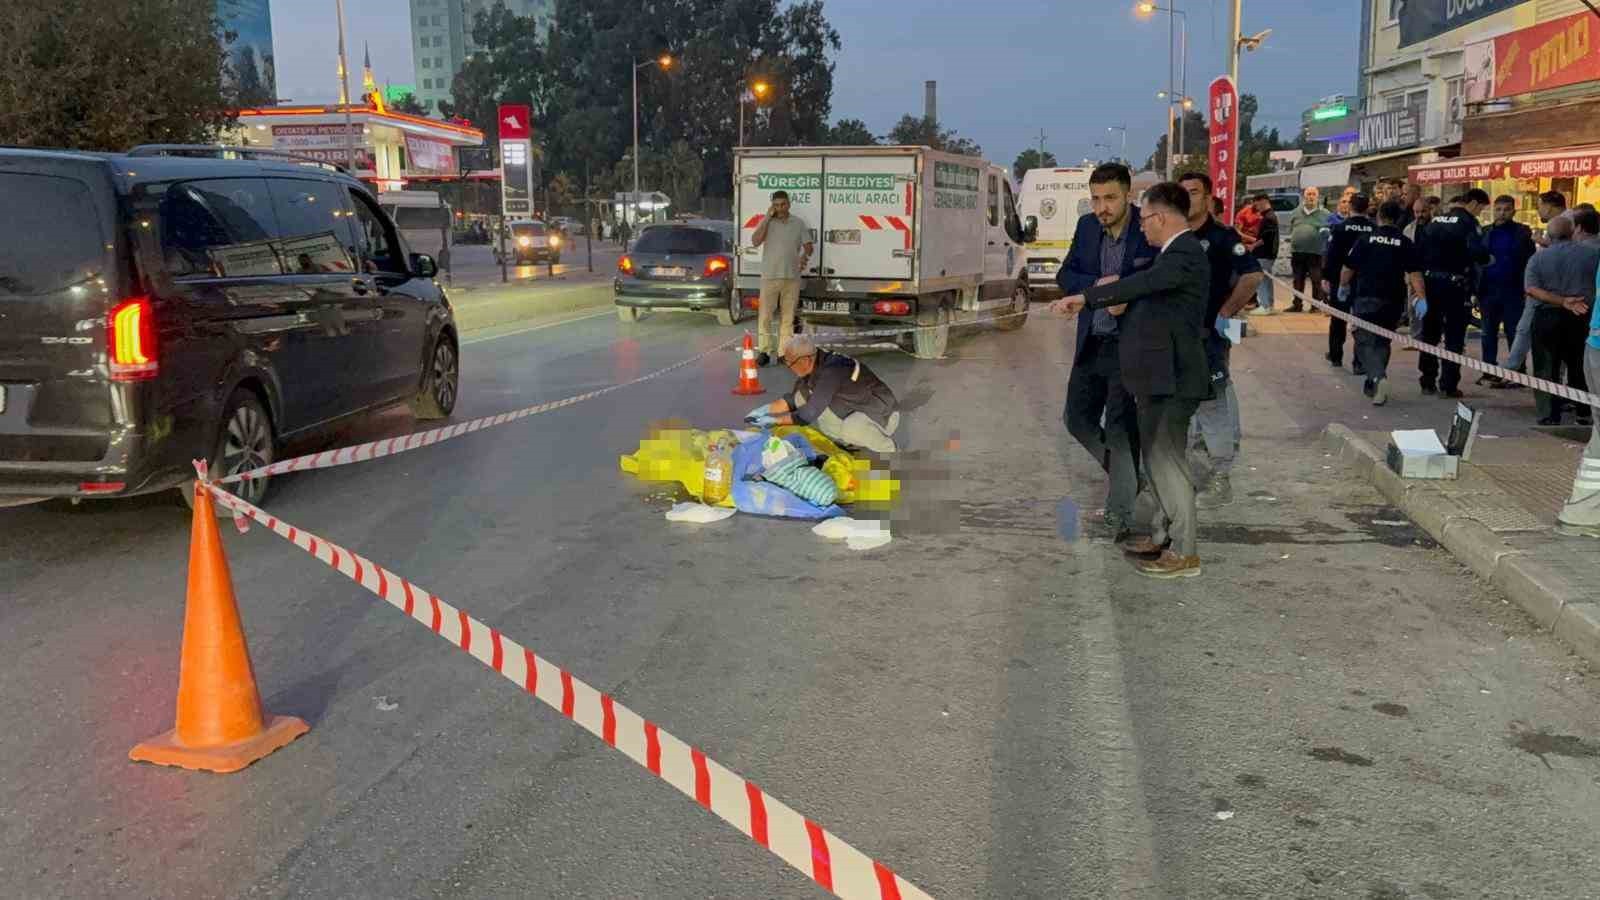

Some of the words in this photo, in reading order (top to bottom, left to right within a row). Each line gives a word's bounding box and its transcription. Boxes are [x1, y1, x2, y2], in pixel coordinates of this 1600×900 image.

[1360, 112, 1399, 152] AKYOLLU
[1559, 157, 1592, 172] TATLICI
[828, 175, 894, 188] BELEDİYESİ
[865, 192, 900, 204] ARACI
